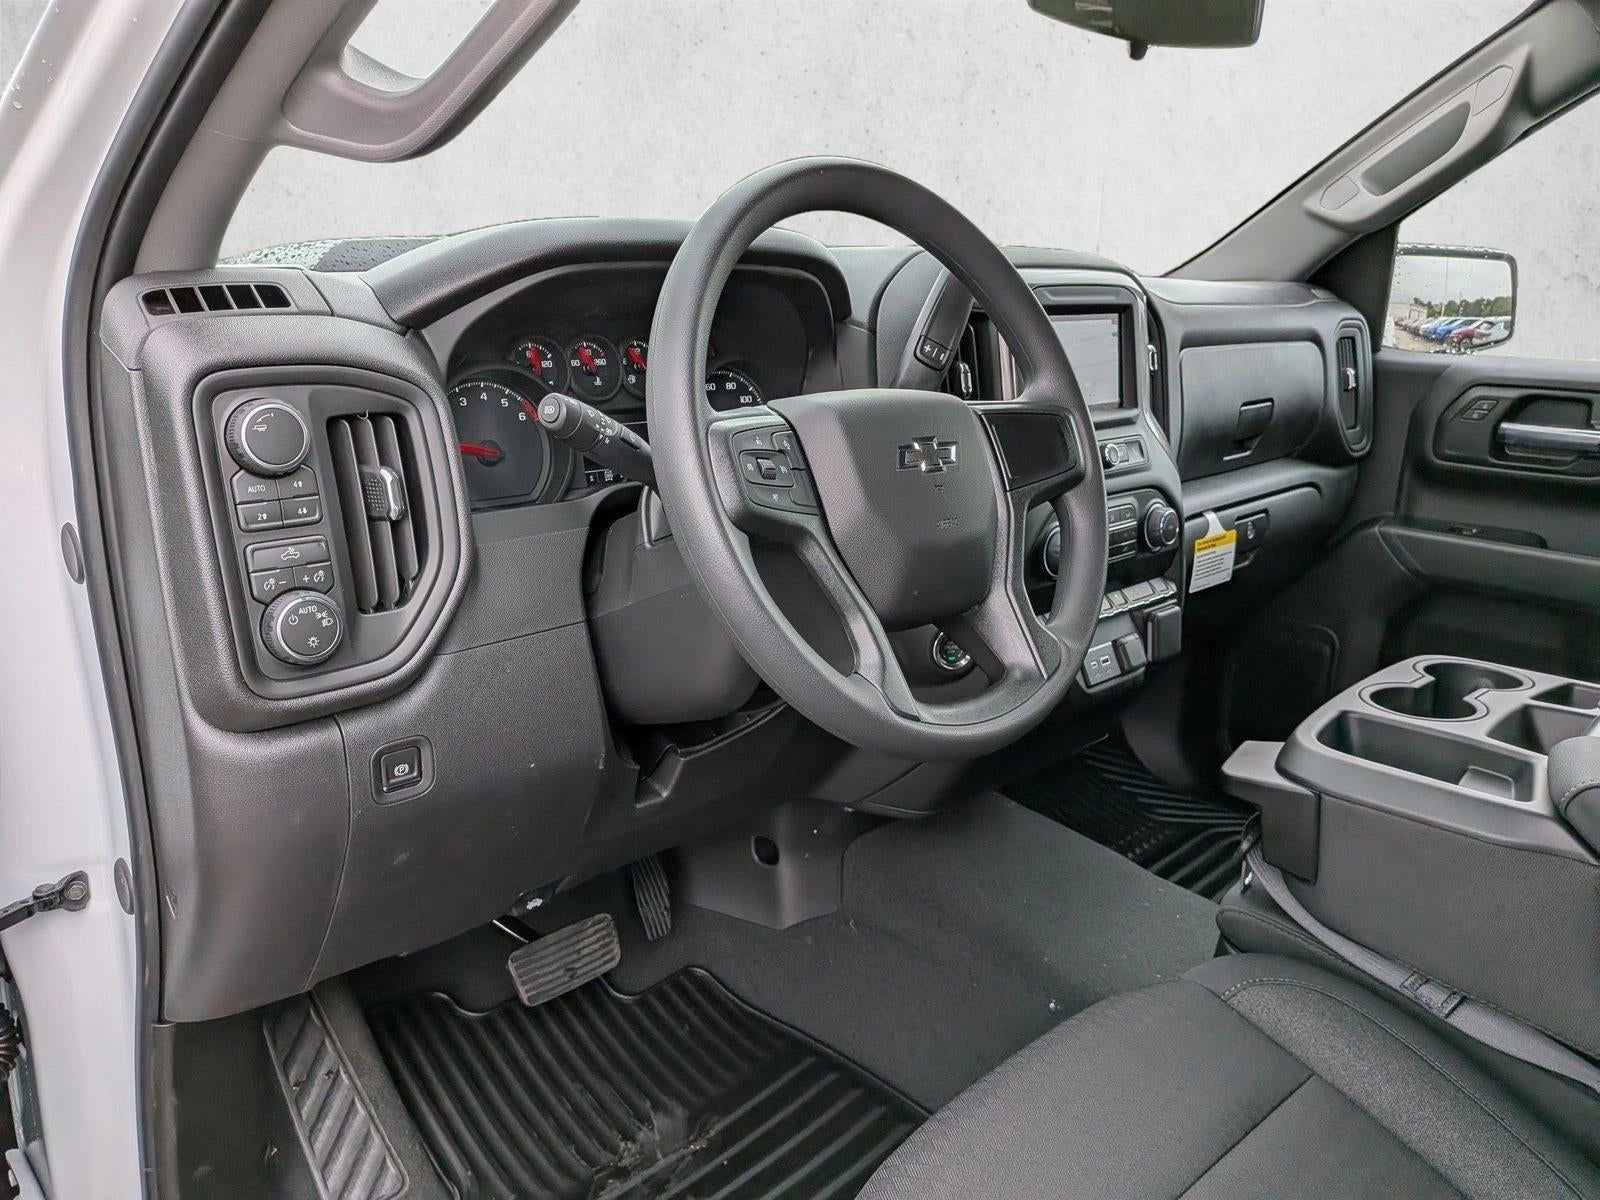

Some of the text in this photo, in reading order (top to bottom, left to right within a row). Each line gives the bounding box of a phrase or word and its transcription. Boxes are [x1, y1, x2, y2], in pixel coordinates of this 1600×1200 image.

[725, 381, 737, 390] 80
[480, 392, 488, 401] 4
[739, 395, 753, 404] 100
[459, 397, 468, 406] 3
[500, 398, 509, 407] 5
[518, 412, 526, 421] 6
[247, 484, 266, 493] AUTO
[298, 605, 318, 615] AUTO
